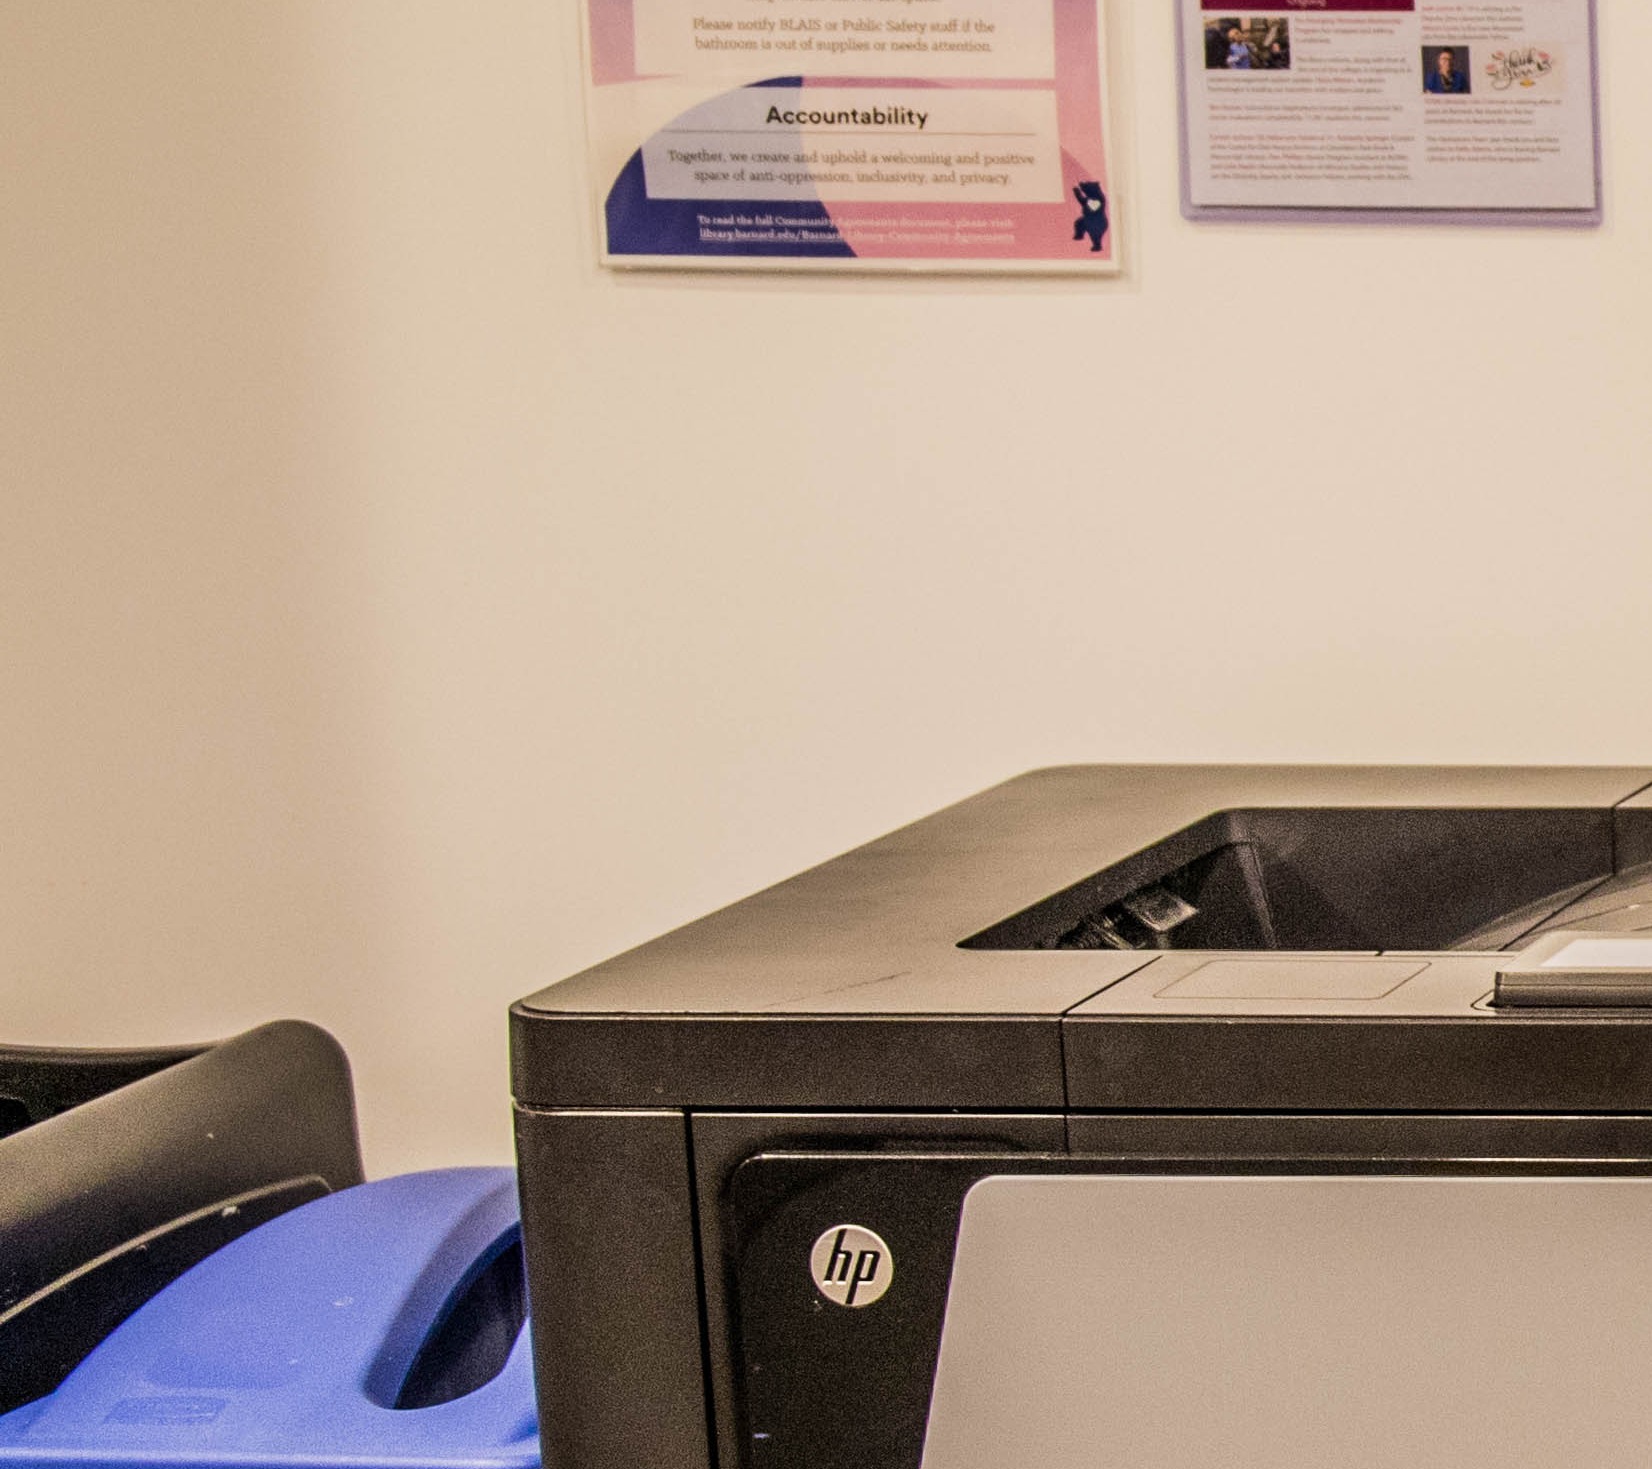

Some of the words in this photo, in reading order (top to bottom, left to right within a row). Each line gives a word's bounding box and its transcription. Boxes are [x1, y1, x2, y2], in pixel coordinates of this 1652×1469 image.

[766, 106, 928, 130] Accountability
[668, 149, 726, 165] Together,
[729, 151, 747, 163] we
[751, 152, 791, 163] create
[794, 149, 818, 163] and
[821, 149, 867, 166] uphold
[871, 154, 879, 164] a
[881, 151, 952, 167] welcoming
[955, 151, 980, 165] and
[984, 152, 1034, 167] positive
[823, 1228, 881, 1304] hp
